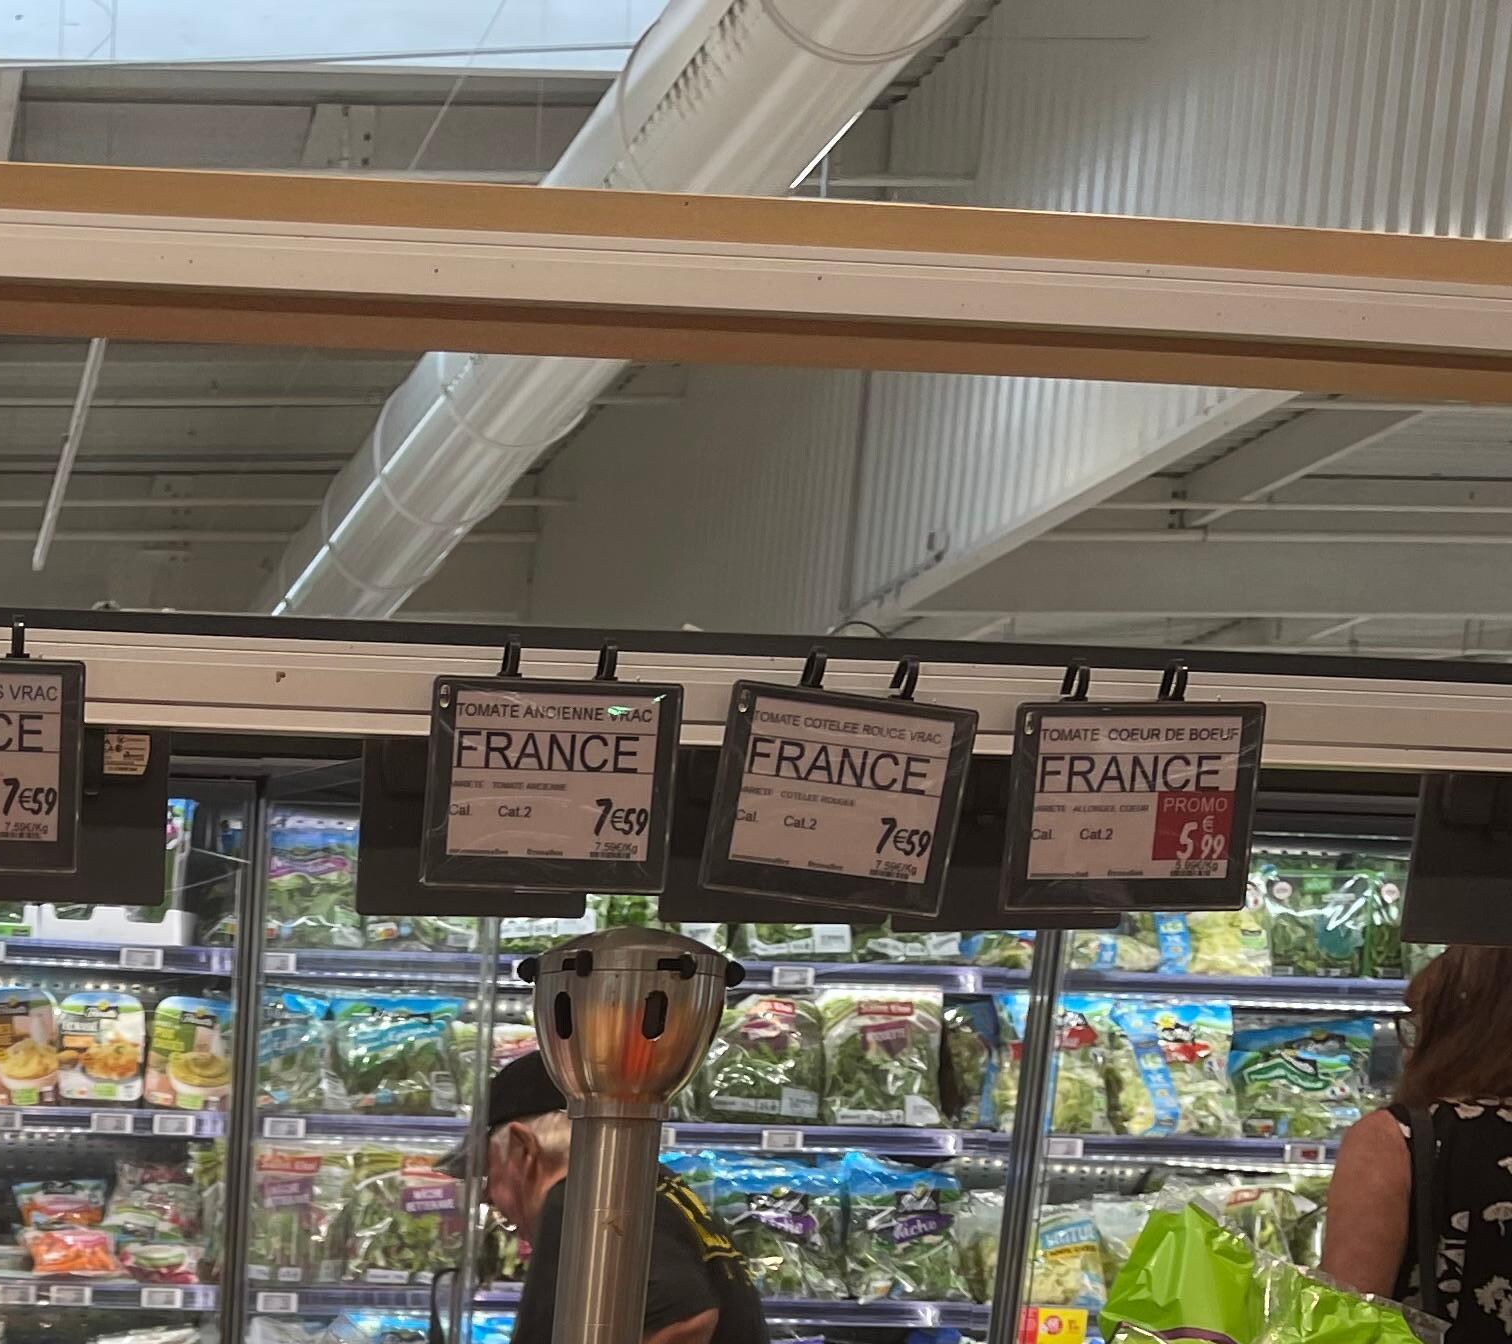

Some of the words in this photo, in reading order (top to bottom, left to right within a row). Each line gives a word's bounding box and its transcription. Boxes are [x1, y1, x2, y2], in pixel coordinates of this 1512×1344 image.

[9, 684, 59, 702] VRAC
[457, 702, 519, 718] TOMATE
[523, 704, 604, 722] ANCIENNE
[754, 709, 801, 728] TOMATE
[803, 716, 860, 734] COTELEE
[908, 730, 942, 745] VRAC
[1042, 727, 1101, 742] TOMATE
[1107, 727, 1161, 742] COEUR
[1164, 727, 1185, 741] DE
[1188, 727, 1240, 741] BOEUF
[456, 730, 640, 774] FRANCE
[748, 736, 931, 796] FRANCE
[1039, 755, 1222, 793] FRANCE
[2, 777, 58, 817] 7€59
[1162, 797, 1229, 813] PROMO
[498, 805, 533, 819] Cat.2
[593, 797, 649, 837] 7€59
[783, 814, 818, 831] Cat.2
[875, 817, 932, 858] 7€59
[1079, 828, 1114, 841] Cat.2
